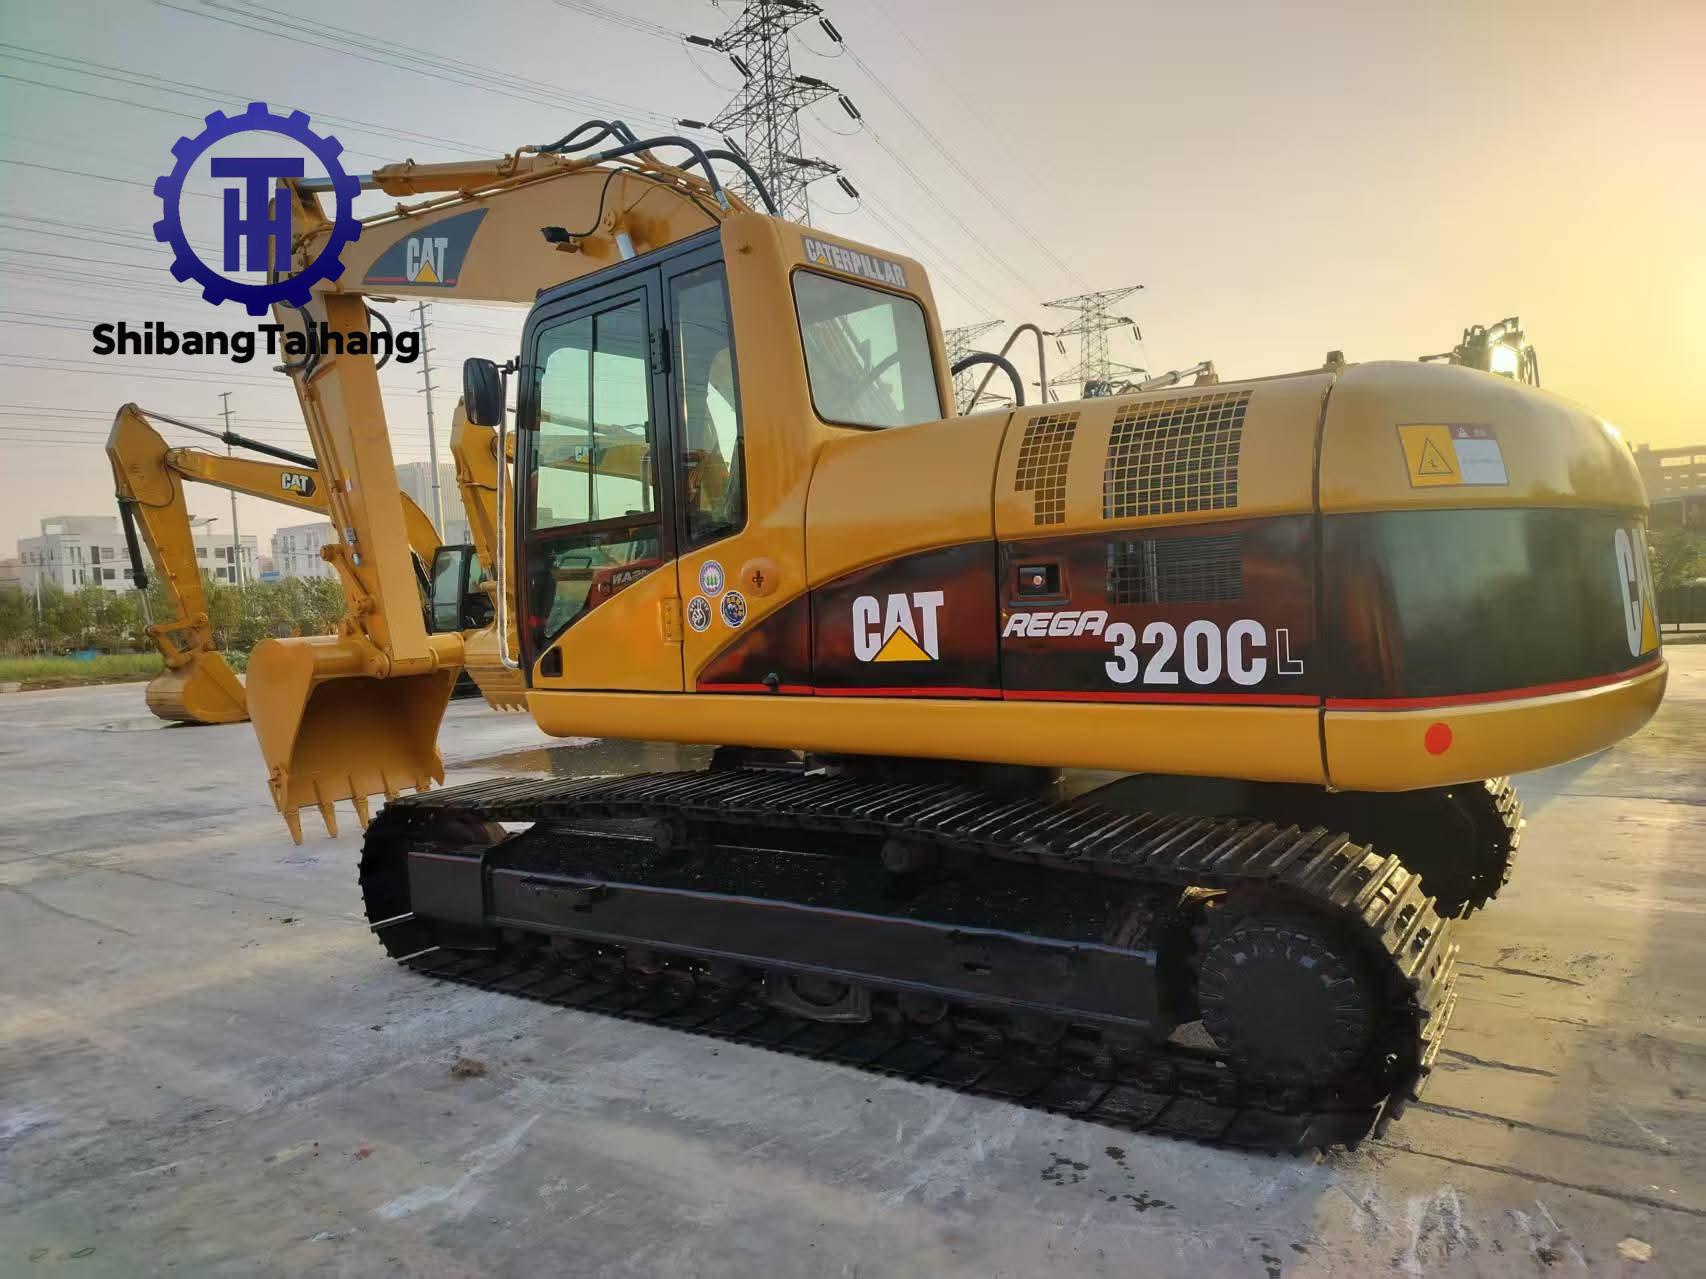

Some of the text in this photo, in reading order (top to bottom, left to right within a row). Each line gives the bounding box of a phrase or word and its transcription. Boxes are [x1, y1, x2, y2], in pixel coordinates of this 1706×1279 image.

[407, 237, 448, 283] CAT
[804, 238, 907, 288] CATERPILLAR
[282, 472, 309, 491] CAT
[853, 590, 944, 662] CAT
[1002, 610, 1109, 637] REGA
